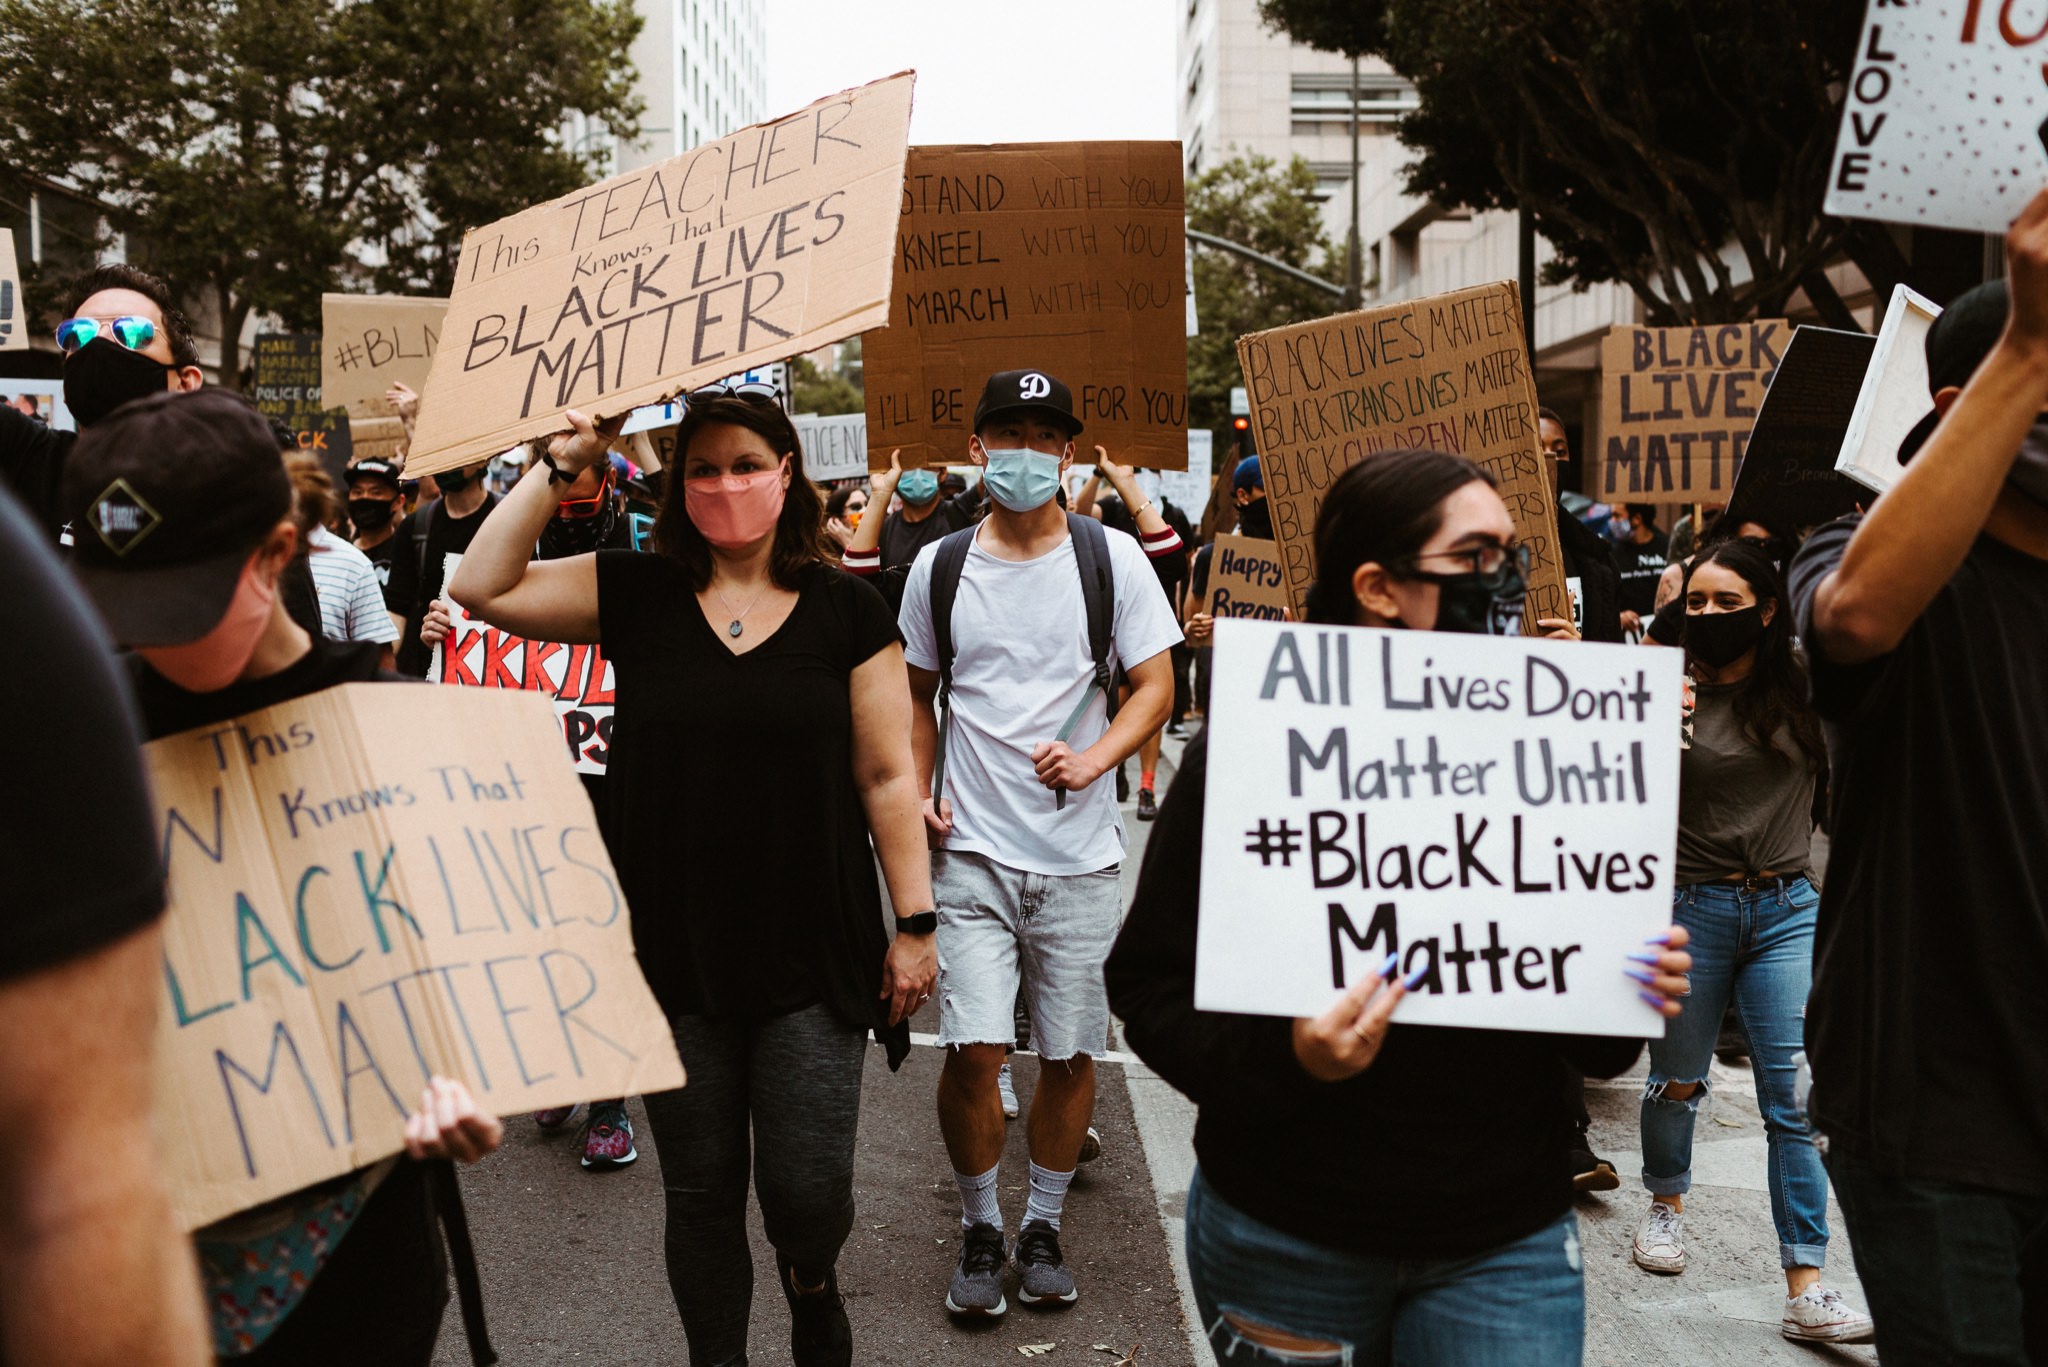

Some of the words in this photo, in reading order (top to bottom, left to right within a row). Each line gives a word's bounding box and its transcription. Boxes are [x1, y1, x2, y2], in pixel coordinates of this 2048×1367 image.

[1836, 24, 1896, 191] LOVE
[468, 233, 540, 283] This
[563, 101, 862, 251] TEACHER
[1032, 176, 1102, 210] WITH
[1119, 176, 1172, 207] YOU
[463, 253, 672, 371] BLACK
[691, 190, 847, 290] LIVES
[571, 243, 653, 282] Knows
[664, 206, 730, 247] That
[901, 230, 1001, 273] KNEEL
[1021, 225, 1098, 257] WITH
[1114, 223, 1168, 258] YOU
[906, 286, 1009, 328] MARCH
[1029, 281, 1101, 315] WITH
[1115, 280, 1172, 311] YOU
[519, 270, 794, 419] MATTER
[1249, 330, 1341, 405] BLACK
[1340, 313, 1425, 377] LIVES
[1430, 294, 1520, 352] MATTER
[1633, 324, 1780, 371] BLACK
[256, 387, 302, 401] POLICE
[931, 388, 963, 424] BE
[1082, 385, 1129, 422] FOR
[1141, 386, 1187, 427] YOU
[1019, 373, 1050, 400] D
[1259, 396, 1338, 451] BLACK
[1331, 380, 1404, 432] TRANS
[1405, 371, 1458, 417] LIVES
[1464, 348, 1525, 398] MATTER
[296, 430, 328, 450] CK
[801, 425, 838, 467] TICE
[1266, 445, 1339, 499] BLACK
[1463, 402, 1536, 452] MATTER
[1211, 587, 1285, 621] Breon
[1220, 548, 1282, 587] Happy
[1260, 631, 1351, 706] All
[1381, 636, 1511, 712] Lives
[1526, 655, 1651, 722] Don't
[199, 721, 315, 771] This
[555, 709, 614, 766] PS
[1287, 727, 1497, 800] Matter
[1514, 738, 1647, 806] Until
[279, 786, 416, 838] Knows
[429, 762, 525, 801] That
[1513, 815, 1659, 892] Lives
[165, 844, 424, 1028] LACK
[427, 825, 619, 936] LIVES
[1328, 903, 1581, 995] Matter
[215, 949, 640, 1179] MATTER
